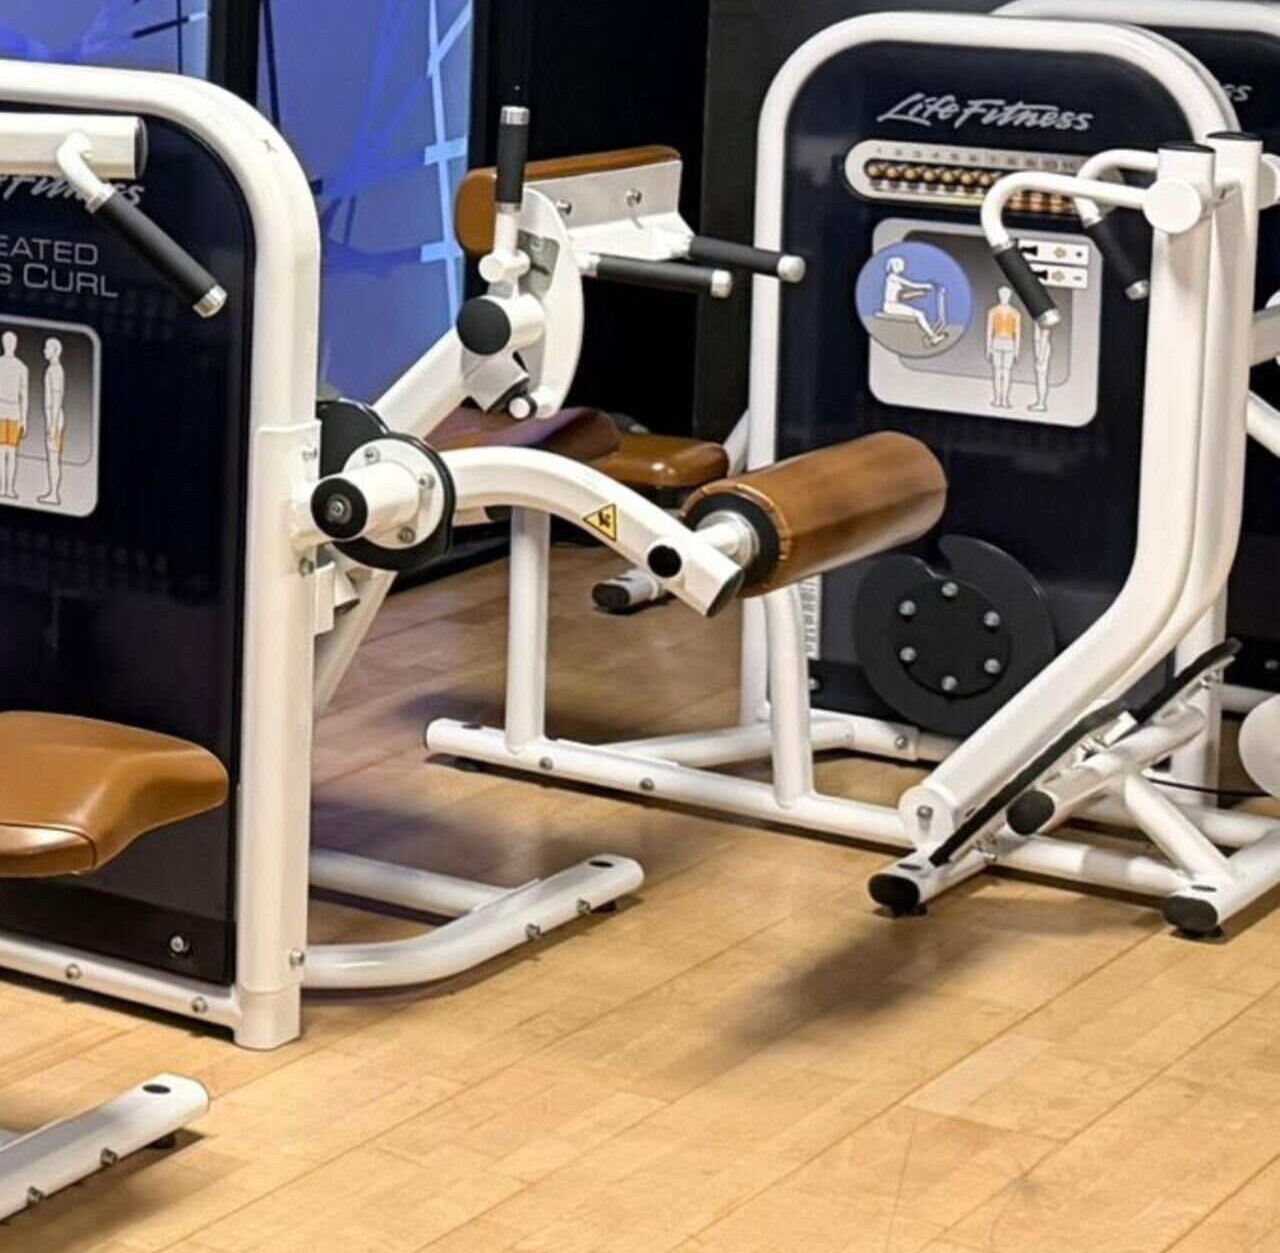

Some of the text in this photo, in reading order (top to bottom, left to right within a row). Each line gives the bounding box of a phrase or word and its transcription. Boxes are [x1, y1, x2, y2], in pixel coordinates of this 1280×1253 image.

[876, 93, 1094, 131] Life Fitness
[23, 263, 119, 298] CURL
